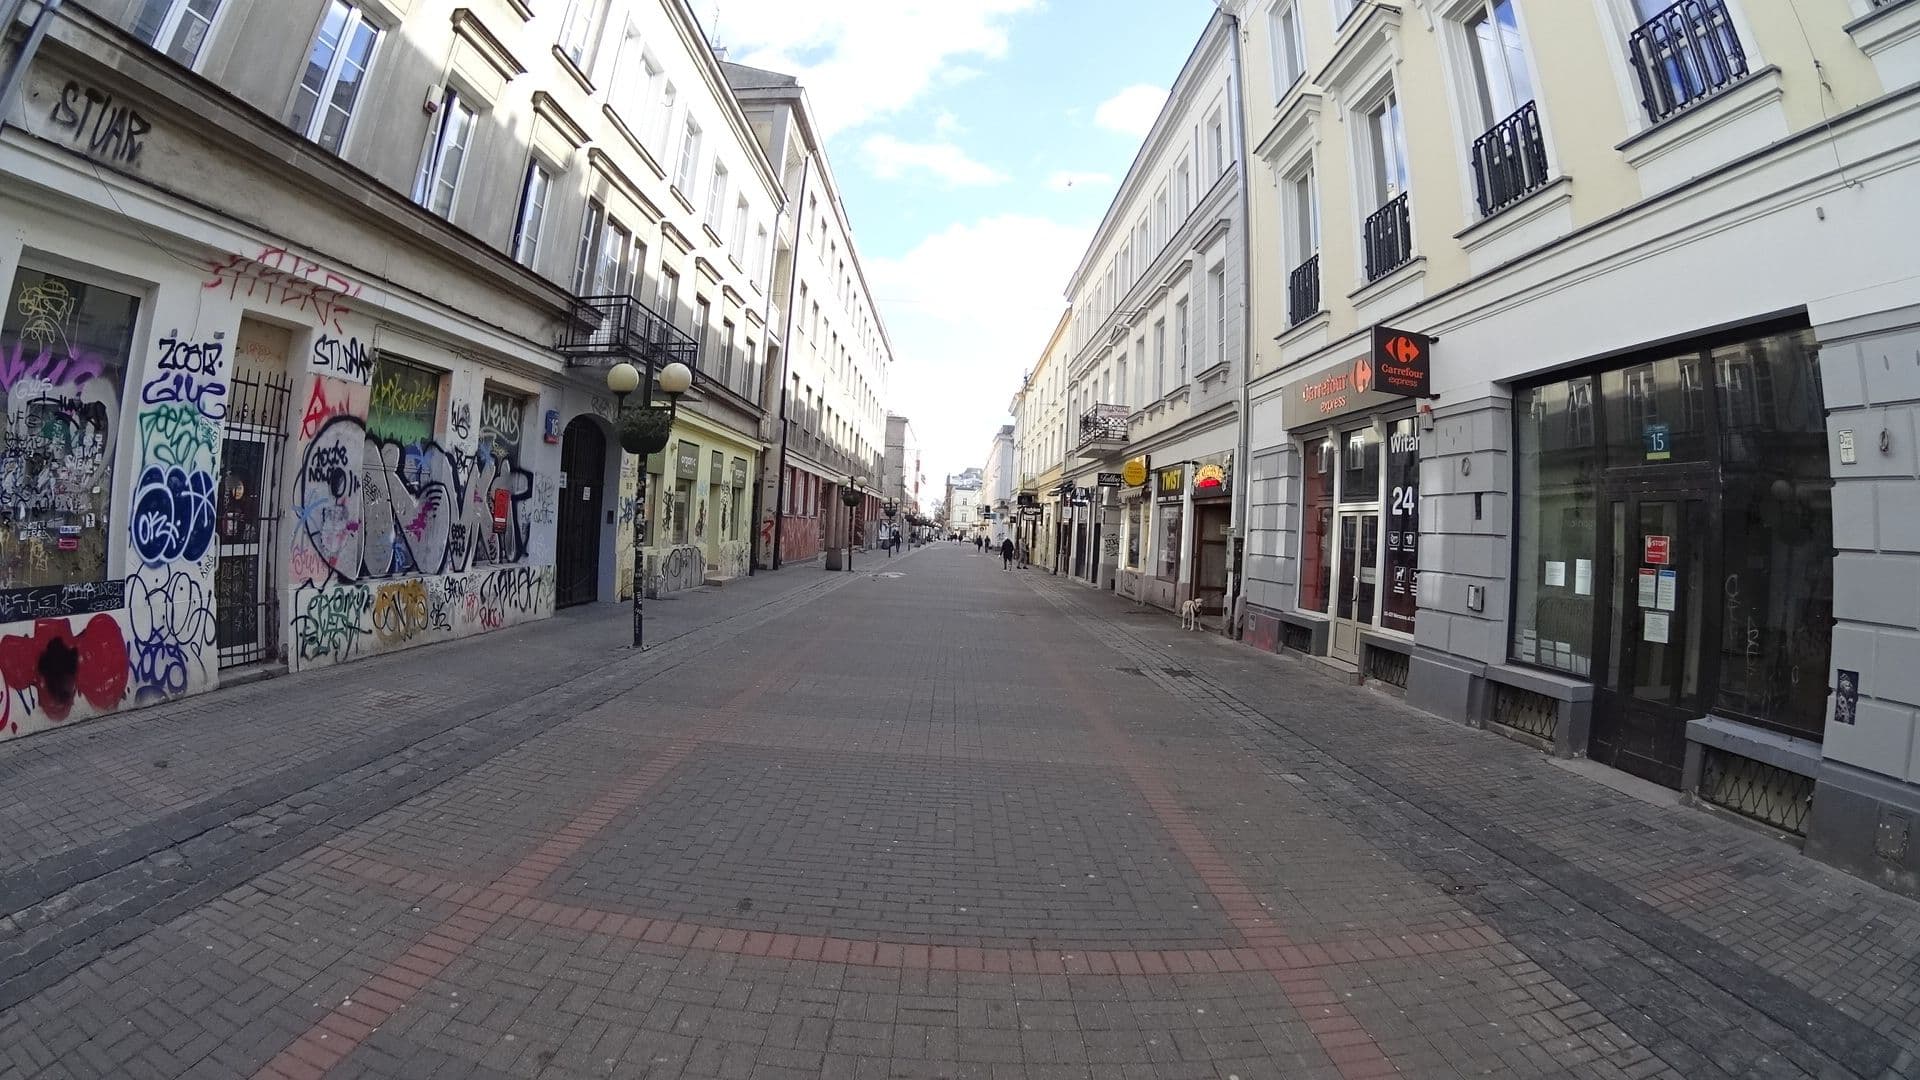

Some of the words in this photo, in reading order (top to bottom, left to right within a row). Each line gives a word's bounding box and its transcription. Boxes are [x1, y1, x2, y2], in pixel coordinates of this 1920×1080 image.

[1381, 363, 1424, 379] Carrefour
[1302, 374, 1348, 402] Carrefour
[1388, 377, 1418, 388] express
[1320, 396, 1347, 414] express
[551, 419, 560, 436] 16
[1651, 432, 1664, 451] 15
[1162, 469, 1182, 491] TWIST
[1392, 486, 1415, 516] 24
